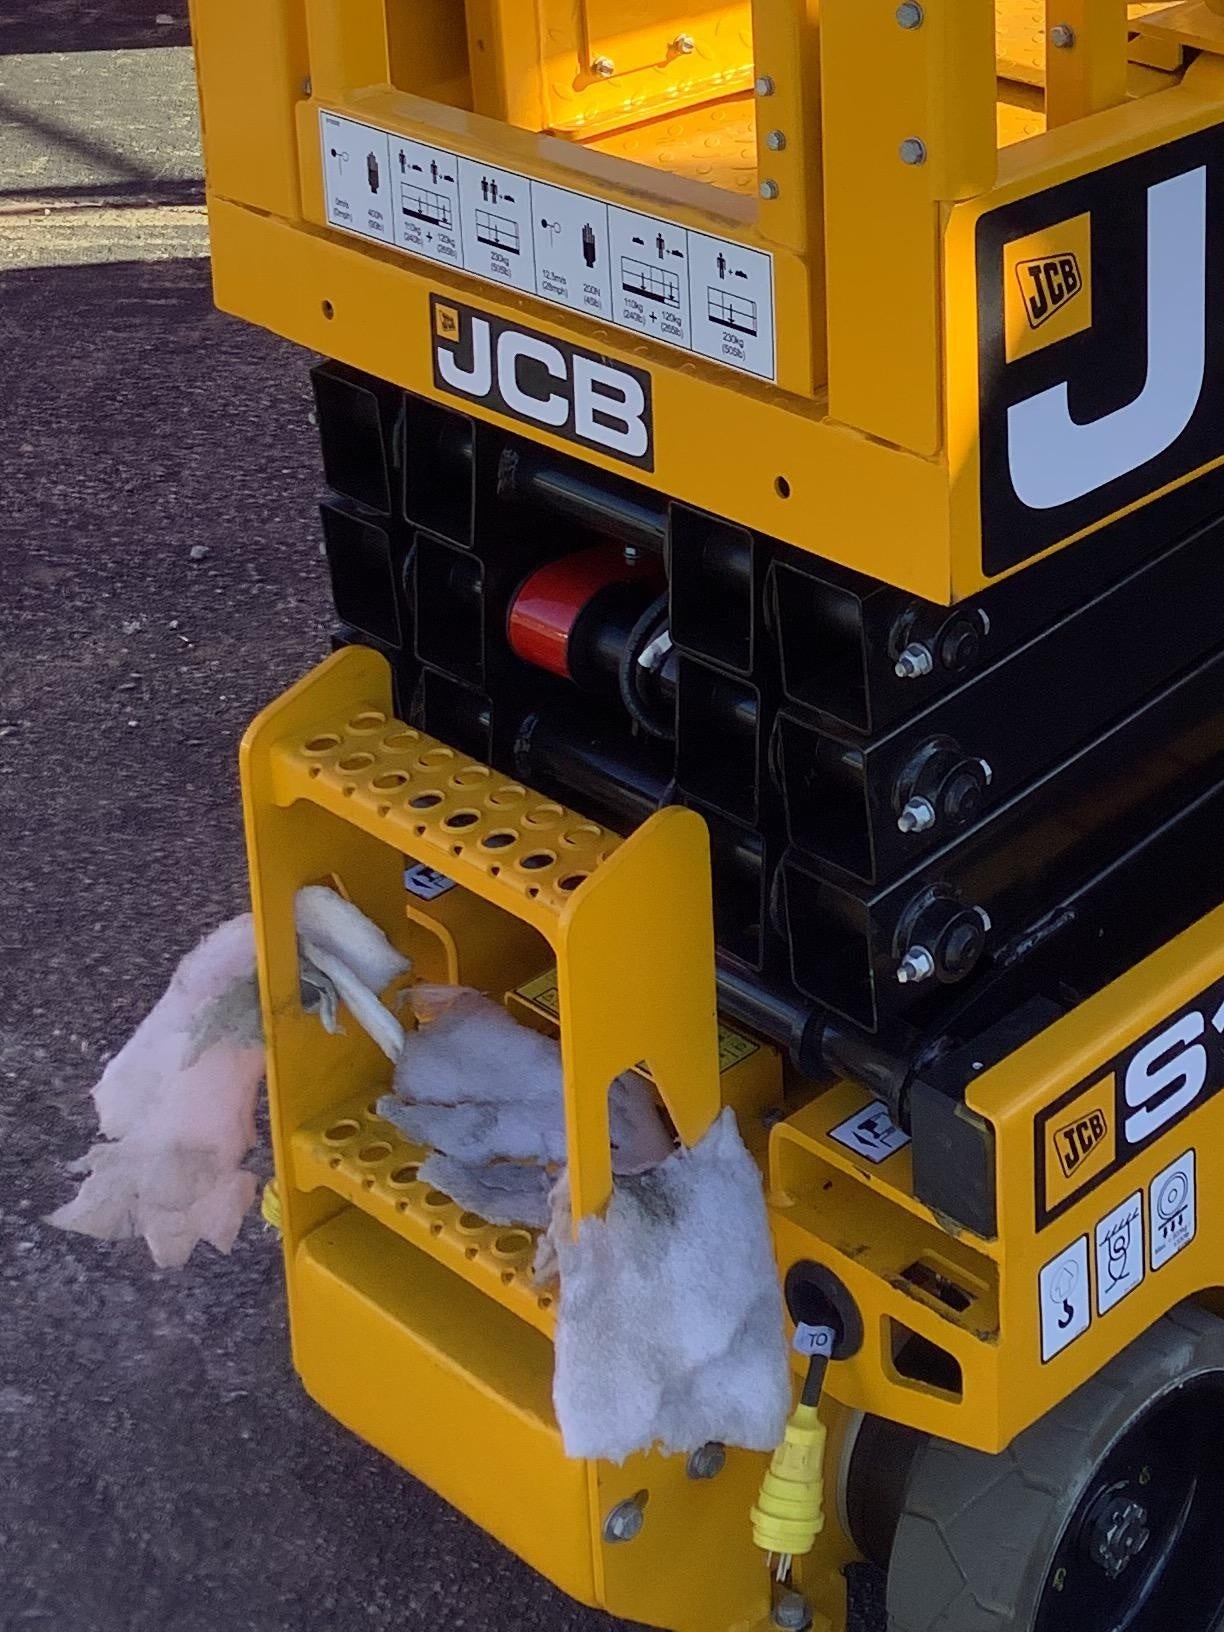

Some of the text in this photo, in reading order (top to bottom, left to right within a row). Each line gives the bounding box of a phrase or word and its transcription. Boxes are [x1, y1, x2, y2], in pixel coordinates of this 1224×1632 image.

[1024, 255, 1080, 321] JCB
[722, 331, 744, 348] 230kg
[437, 316, 649, 457] JCB
[1061, 1112, 1105, 1171] JCB
[808, 1332, 828, 1348] TO
